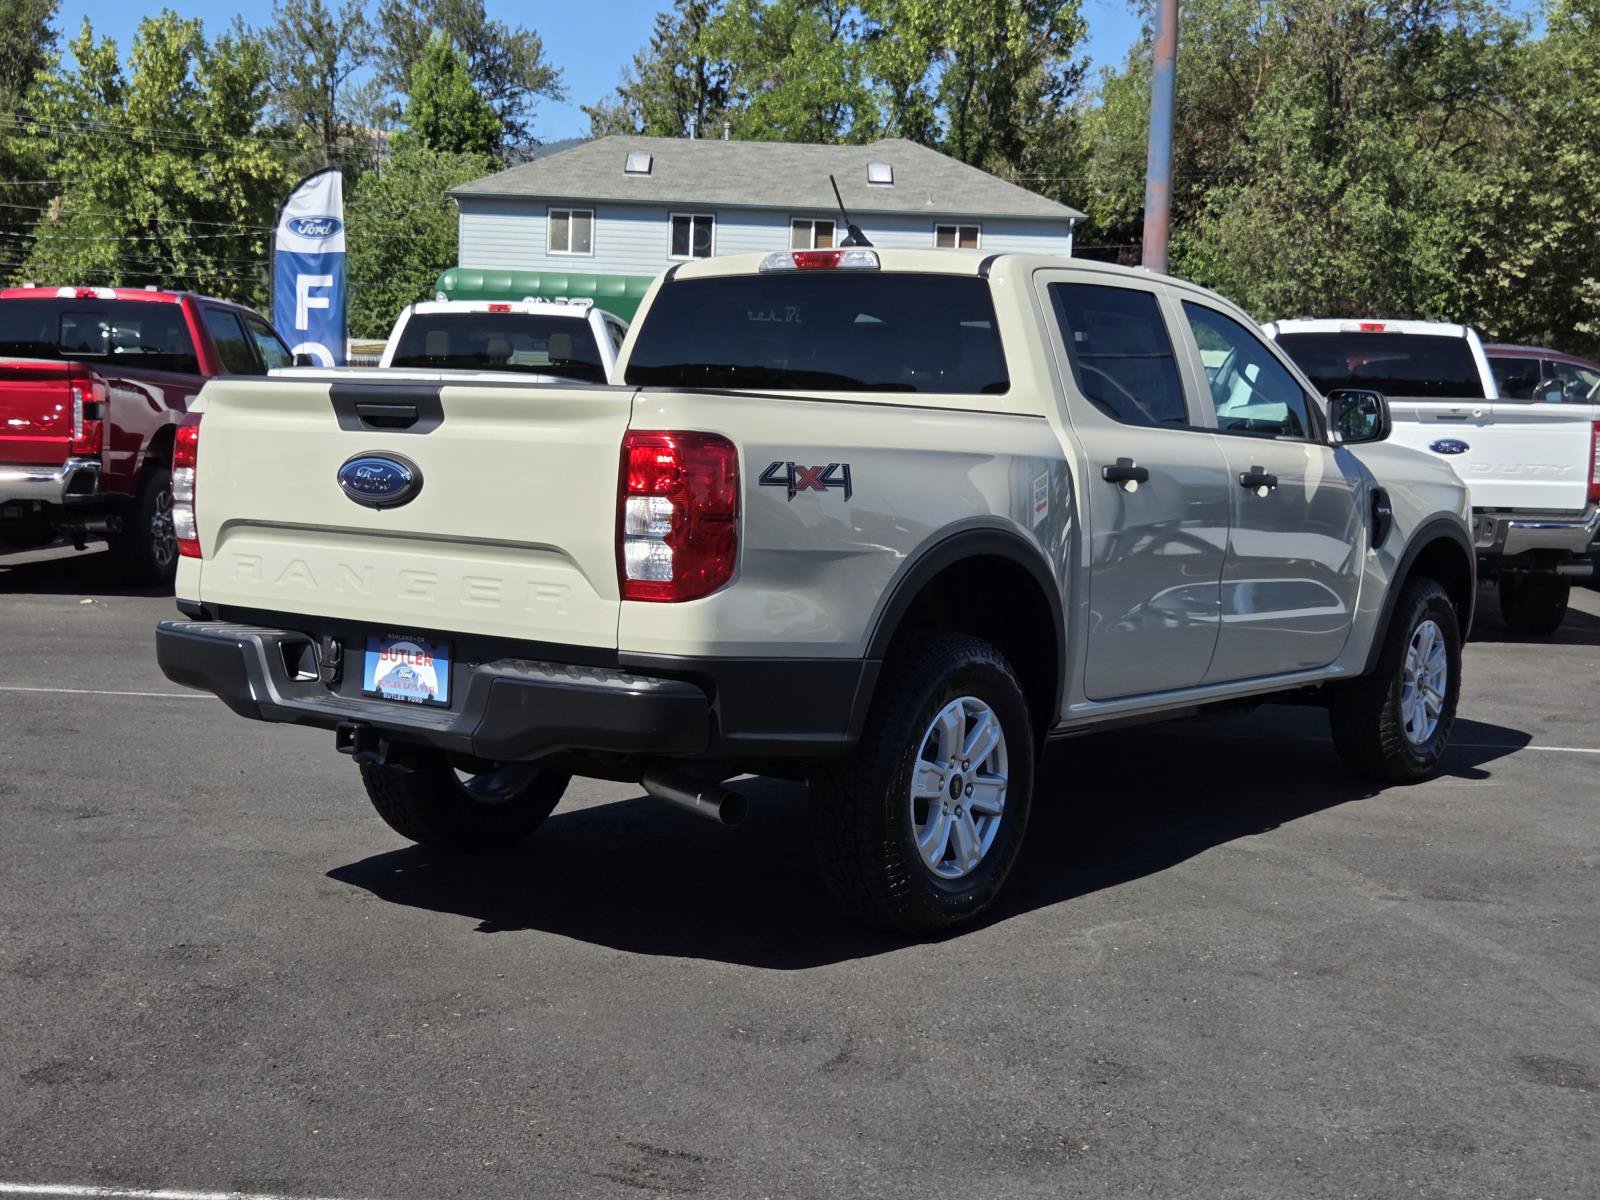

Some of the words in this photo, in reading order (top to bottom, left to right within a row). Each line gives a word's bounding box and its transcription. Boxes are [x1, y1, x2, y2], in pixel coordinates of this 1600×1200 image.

[298, 218, 332, 235] Ford
[1469, 463, 1575, 476] DUTY
[228, 552, 572, 616] RANGER
[381, 647, 433, 667] BUTLER
